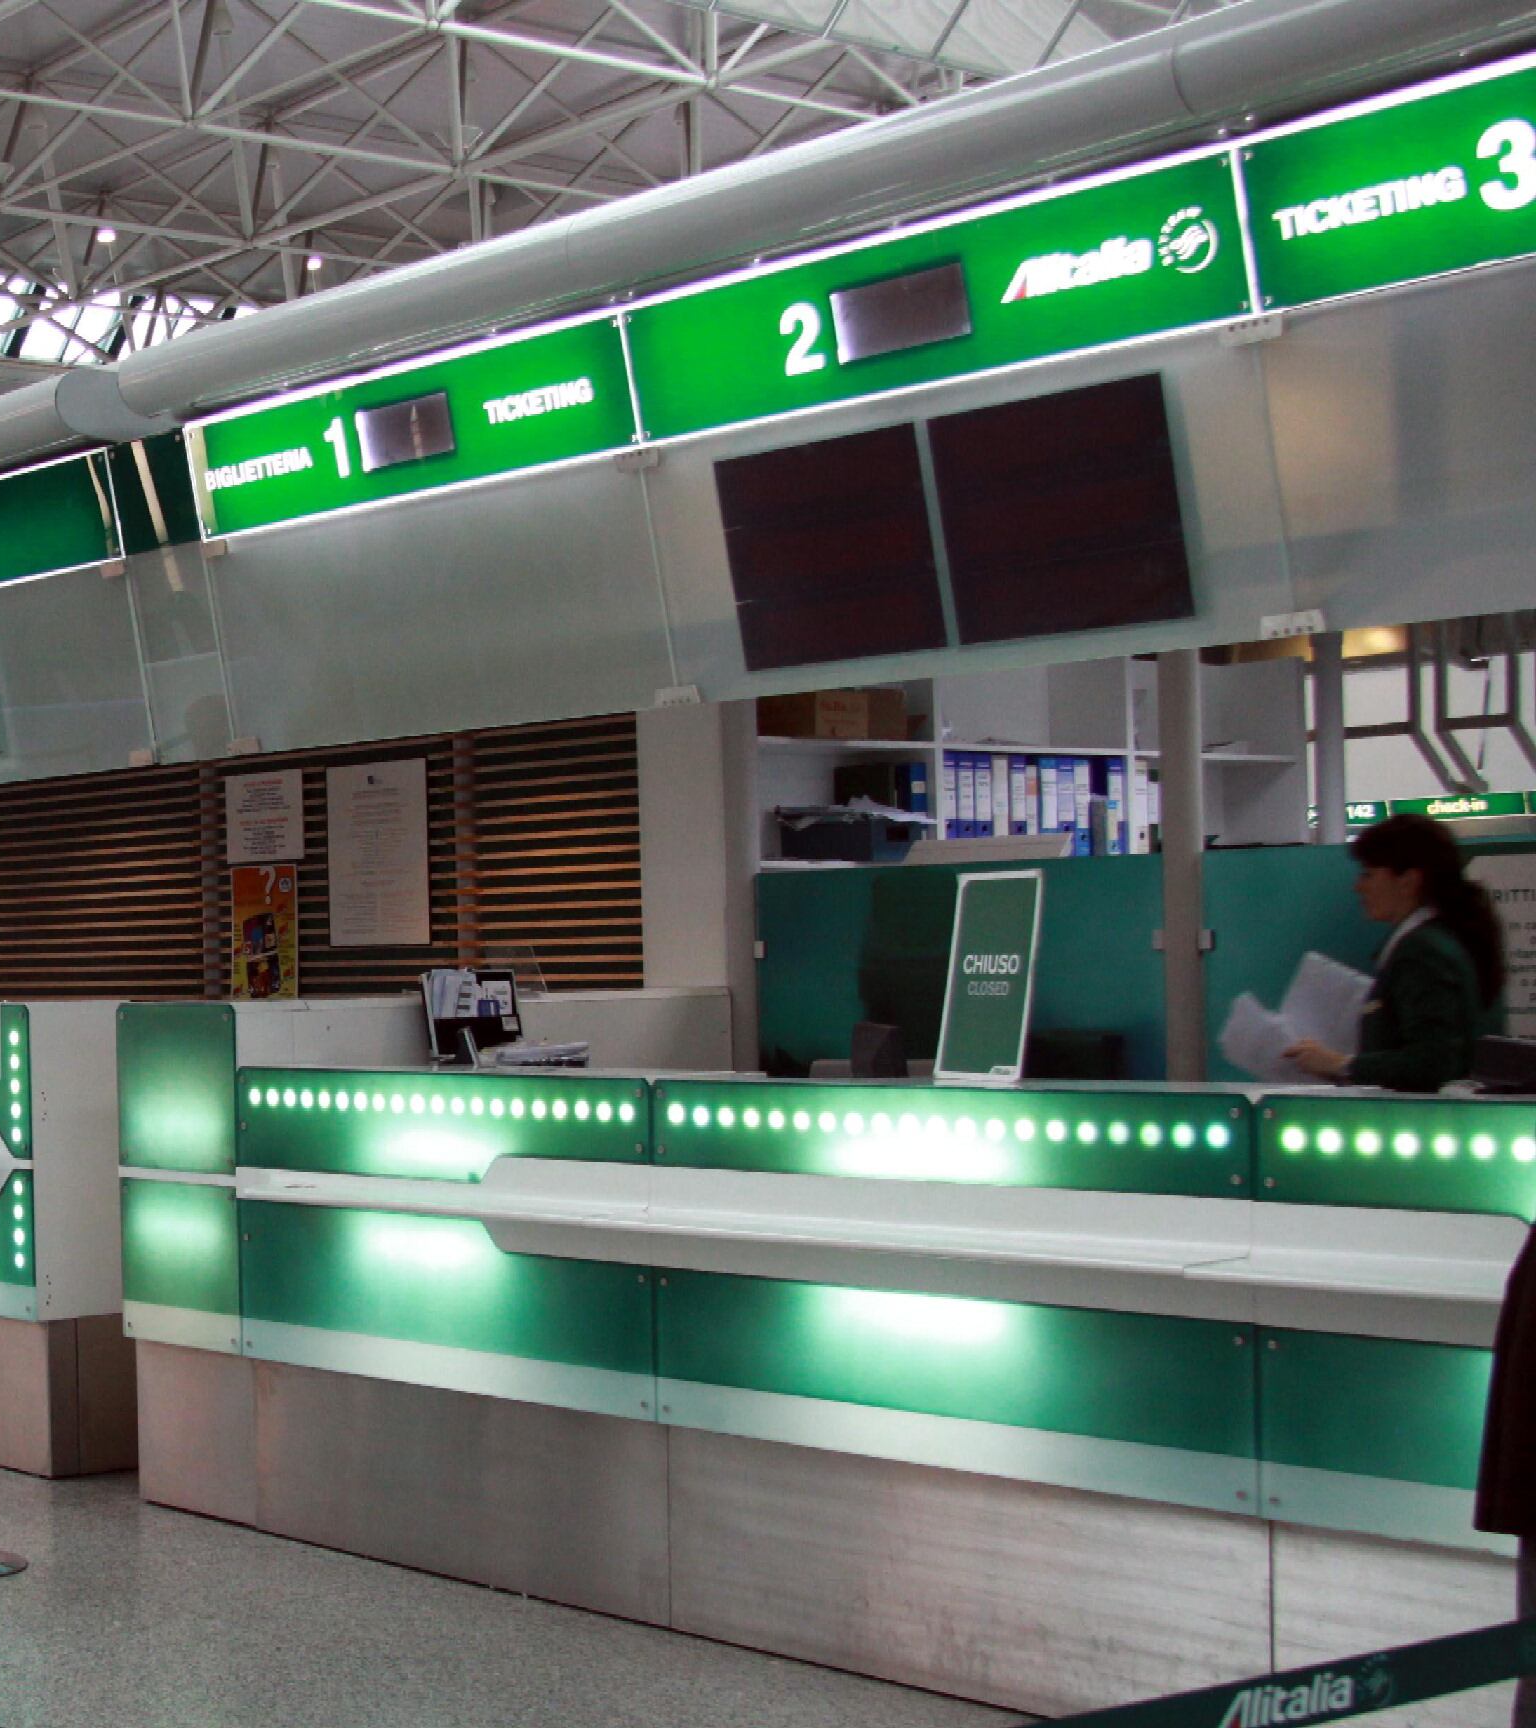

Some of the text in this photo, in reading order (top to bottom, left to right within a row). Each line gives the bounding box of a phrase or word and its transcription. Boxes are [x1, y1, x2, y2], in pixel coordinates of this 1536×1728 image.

[1273, 166, 1467, 241] TICKETING
[1476, 119, 1536, 211] 3
[999, 236, 1153, 304] Alitalia
[778, 302, 826, 376] 2
[483, 376, 594, 424] TICKETING
[204, 416, 352, 491] BIGLIETTERIA 1
[1346, 804, 1376, 820] 142
[1426, 798, 1489, 816] check-in
[963, 955, 1019, 975] CHIUSO
[967, 981, 1009, 996] CLOSED
[1217, 1673, 1355, 1728] Alitalia
